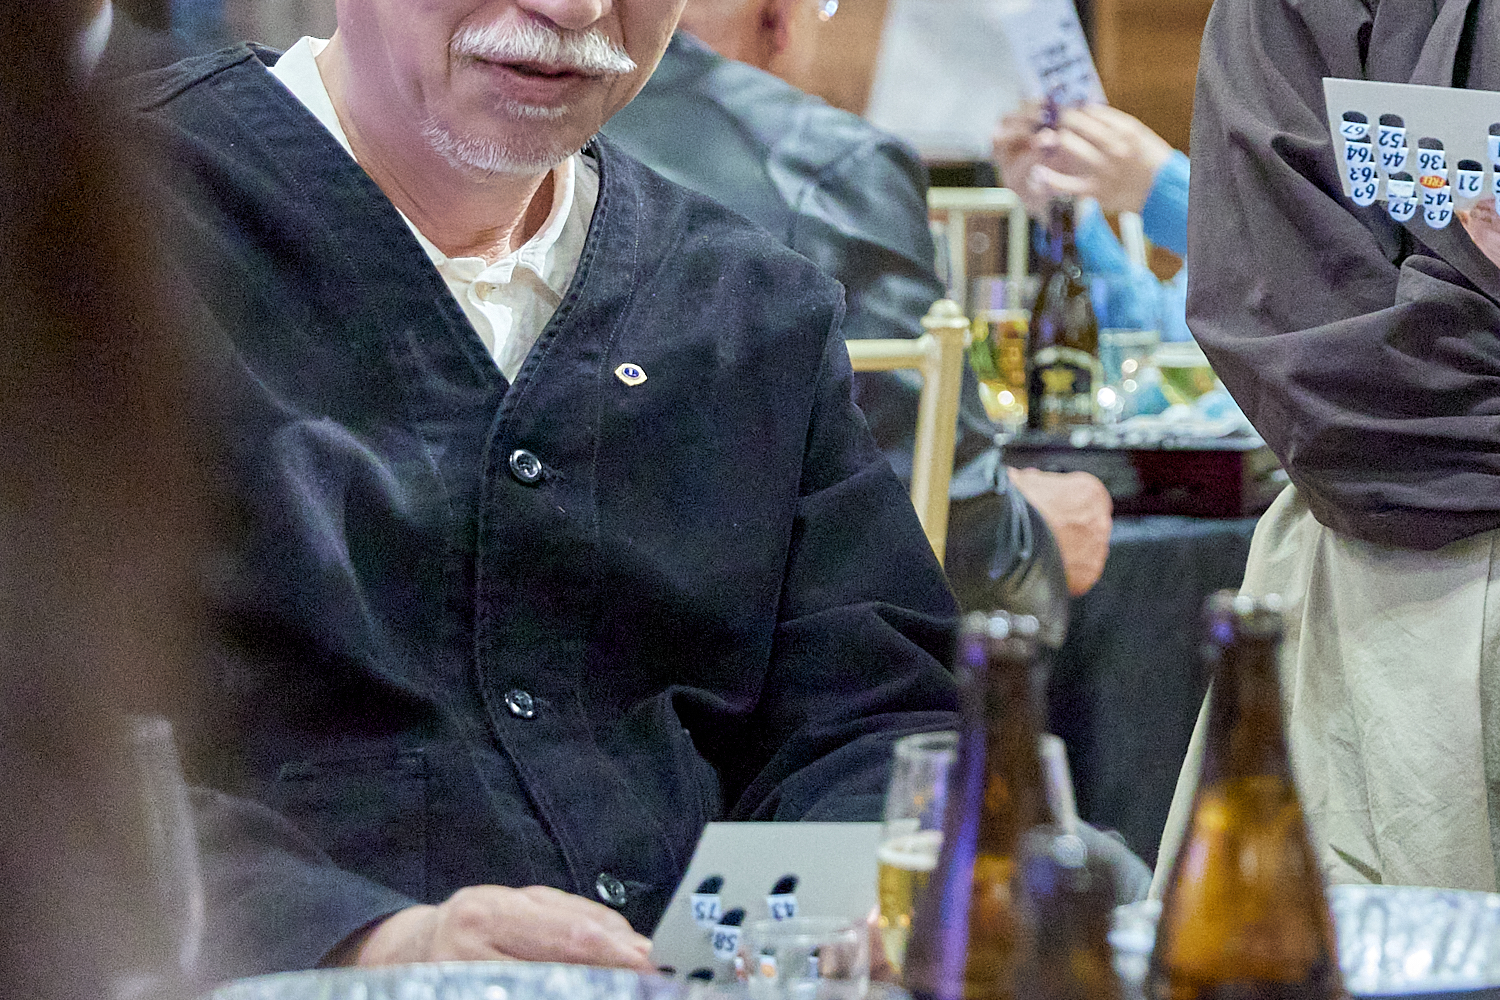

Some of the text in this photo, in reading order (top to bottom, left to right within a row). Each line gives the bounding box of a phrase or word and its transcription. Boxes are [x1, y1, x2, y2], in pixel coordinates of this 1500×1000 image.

[1342, 125, 1365, 135] 67
[1378, 130, 1402, 149] 52
[1346, 146, 1368, 163] 64
[1419, 153, 1442, 170] 36
[1421, 176, 1445, 187] FREE
[1458, 175, 1479, 192] 21
